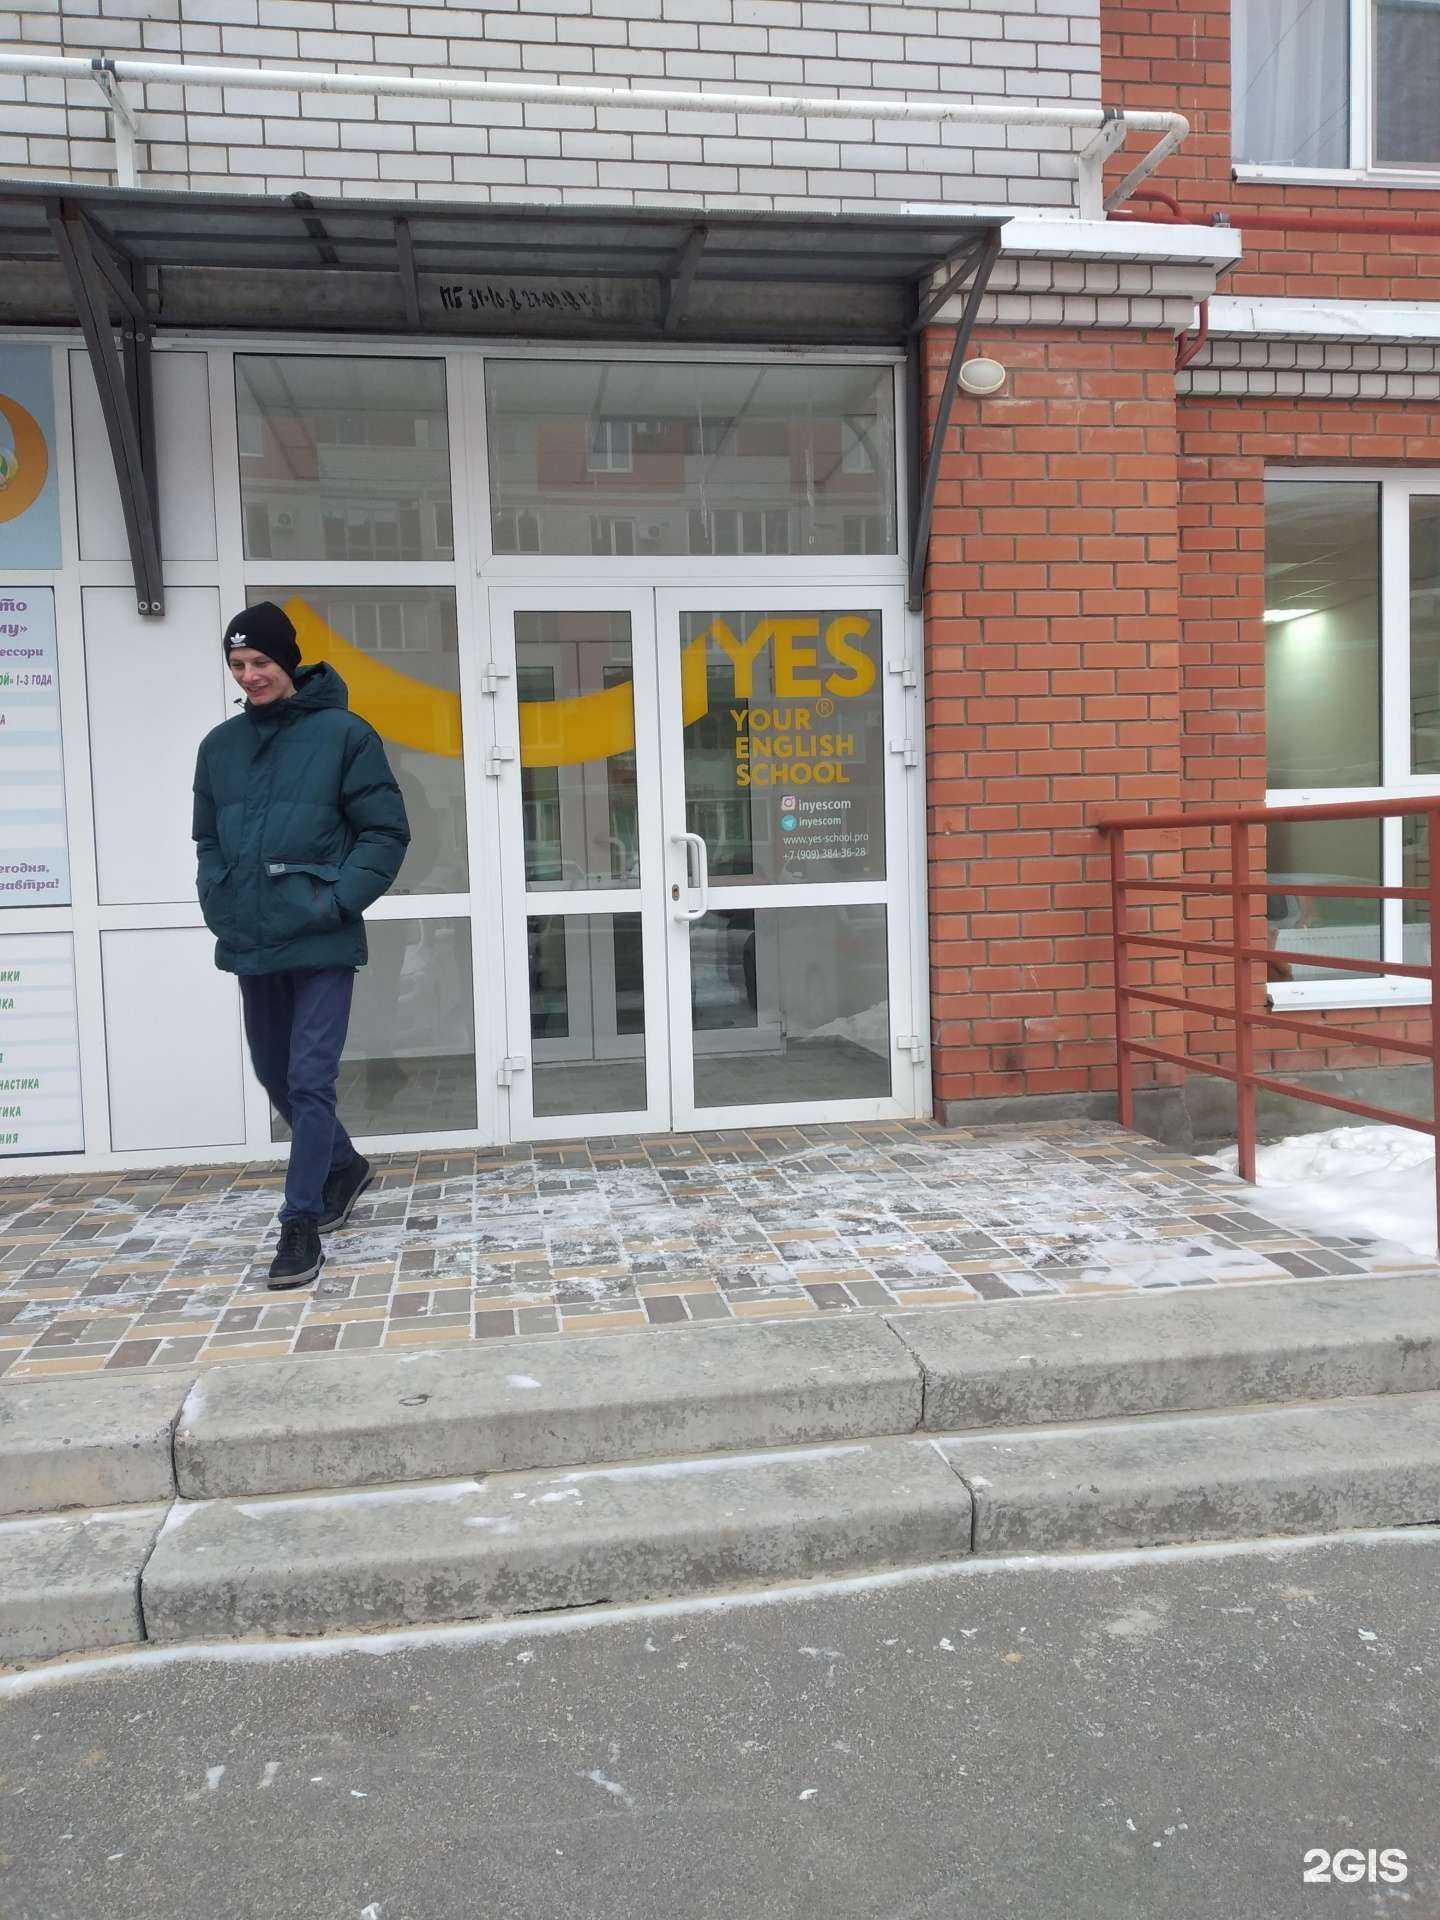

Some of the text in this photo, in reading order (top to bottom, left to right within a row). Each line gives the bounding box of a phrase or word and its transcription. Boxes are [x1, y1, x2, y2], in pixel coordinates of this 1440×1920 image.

[713, 614, 876, 698] YES
[31, 674, 52, 686] ГОДА
[730, 708, 813, 732] YOUR
[735, 735, 854, 760] ENGLISH
[736, 761, 851, 787] SCHOOL
[799, 799, 852, 814] inyescom
[799, 816, 842, 829] inyescom
[783, 831, 869, 846] www.yes-school.pro
